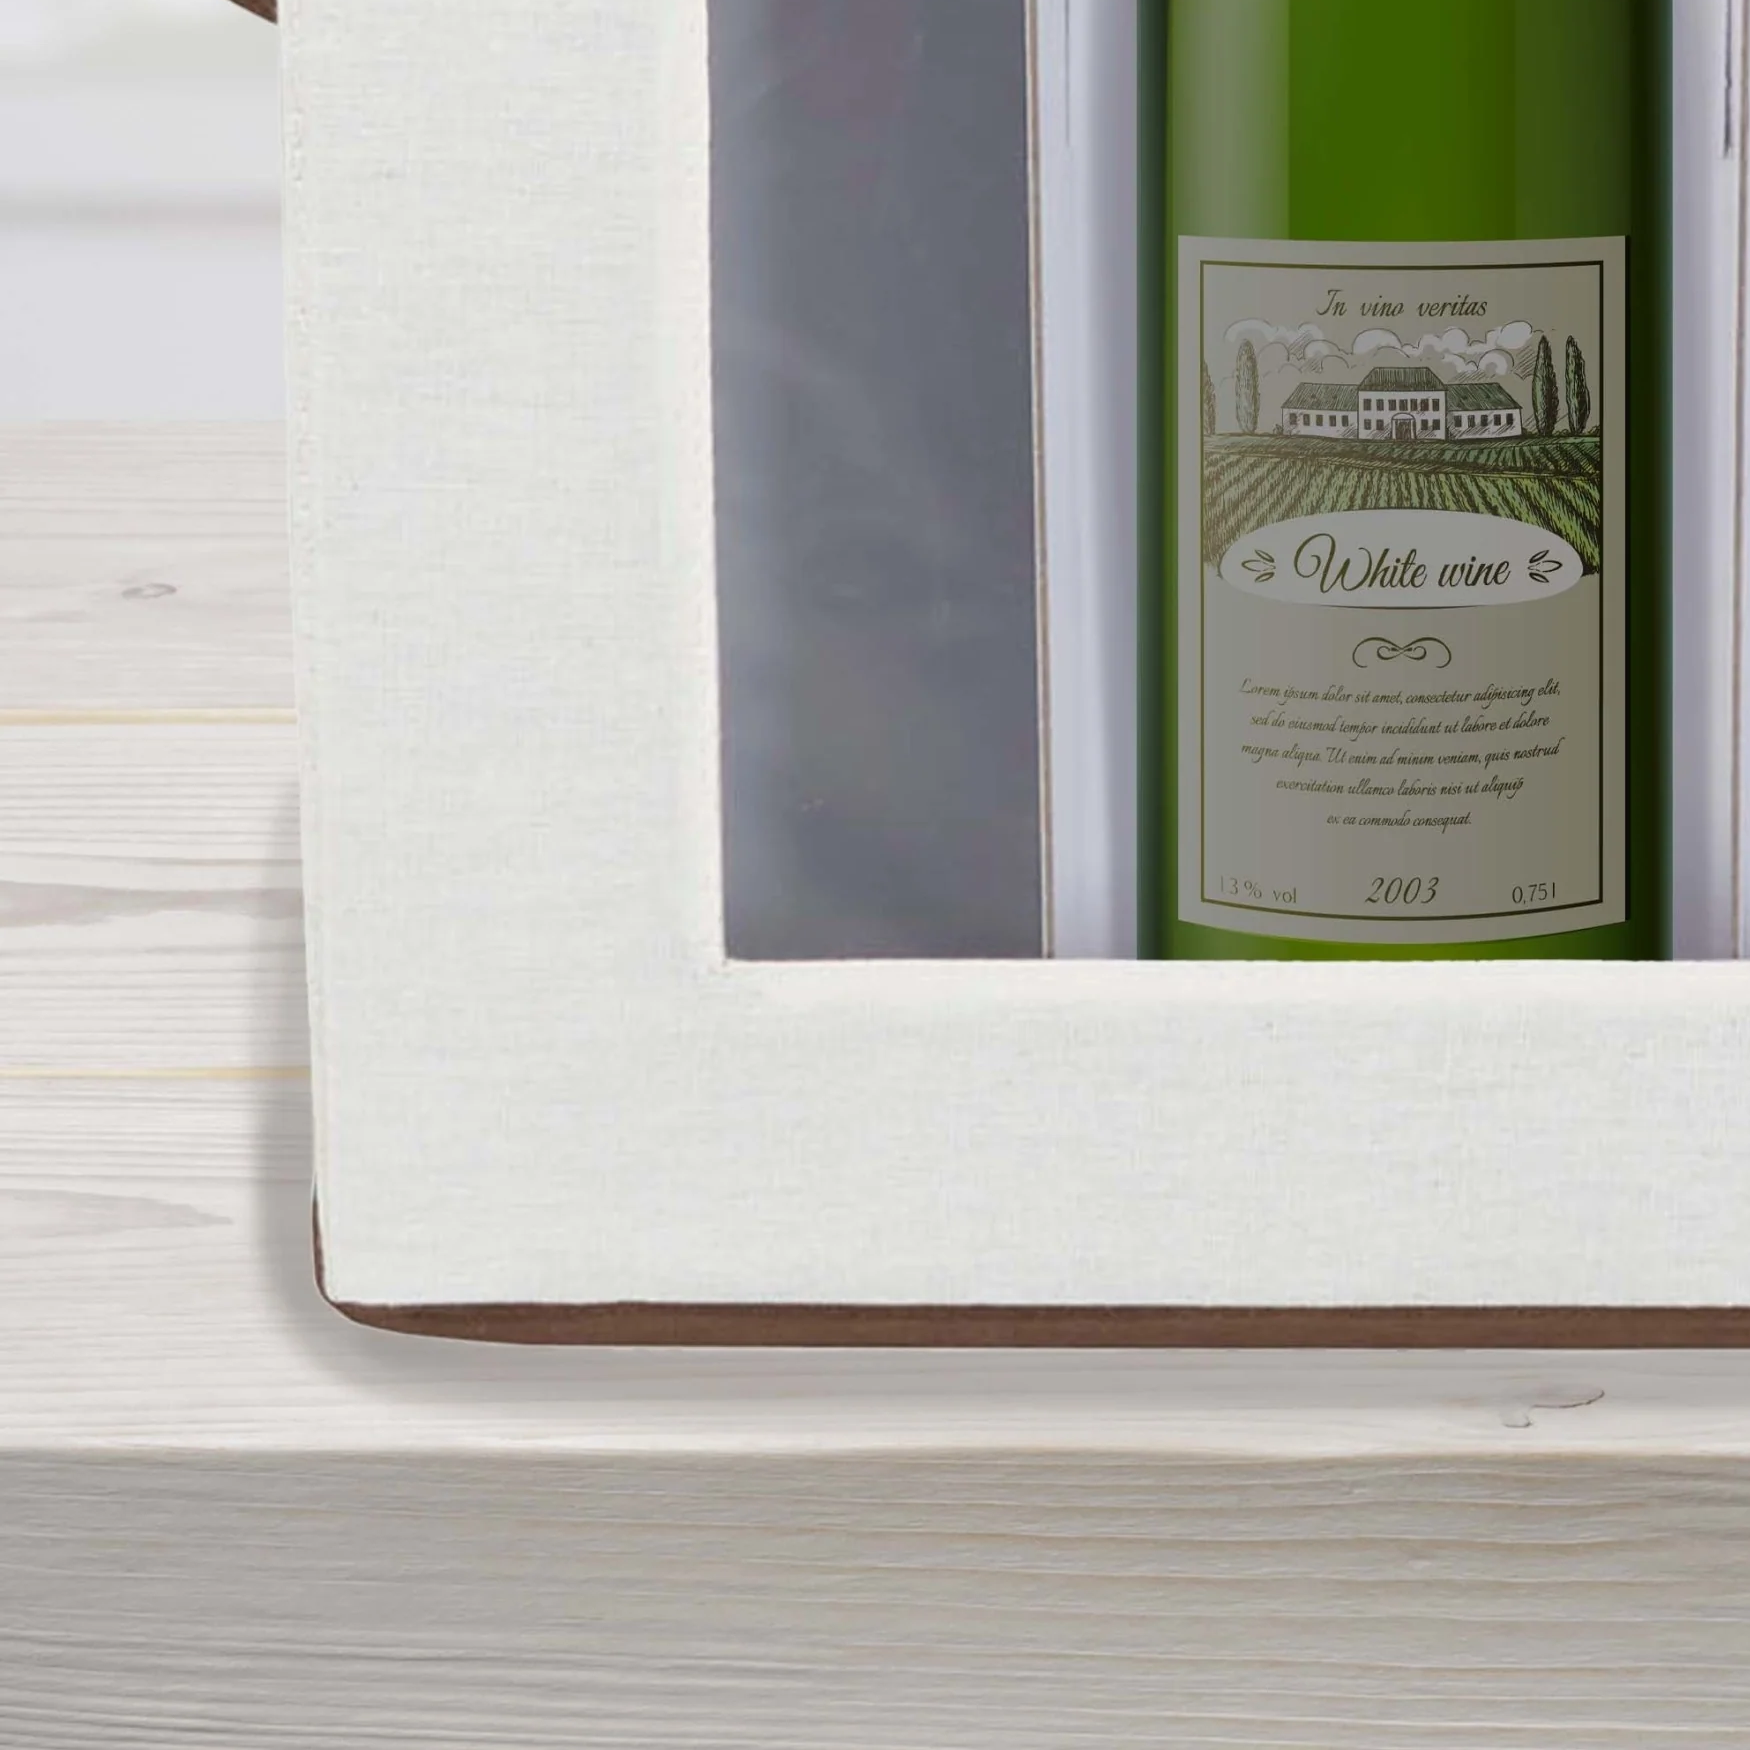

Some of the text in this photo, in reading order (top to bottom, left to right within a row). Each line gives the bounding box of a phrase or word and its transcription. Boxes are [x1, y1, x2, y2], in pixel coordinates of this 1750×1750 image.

[1316, 289, 1488, 317] In vino veritas
[1294, 533, 1511, 593] White wine
[1240, 678, 1560, 709] Lorem ipsum dolor sit amet, consectetur adipisicing elit,
[1251, 710, 1550, 741] sed do eiusmod tempor incididunt ut labore et dolore
[1241, 744, 1279, 763] magna
[1326, 746, 1344, 764] Ut
[1349, 752, 1377, 765] enim
[1380, 748, 1400, 765] ad
[1397, 750, 1434, 765] minim
[1437, 751, 1481, 764] veniam,
[1484, 748, 1510, 770] quis
[1514, 737, 1565, 760] nostrud
[1276, 774, 1524, 799] exercitation ullamco laboris nisi ut aliquip
[1327, 815, 1340, 825] ex
[1343, 815, 1357, 825] ea
[1359, 809, 1411, 826] commodo
[1272, 887, 1297, 903] vol
[1364, 877, 1440, 904] 2003
